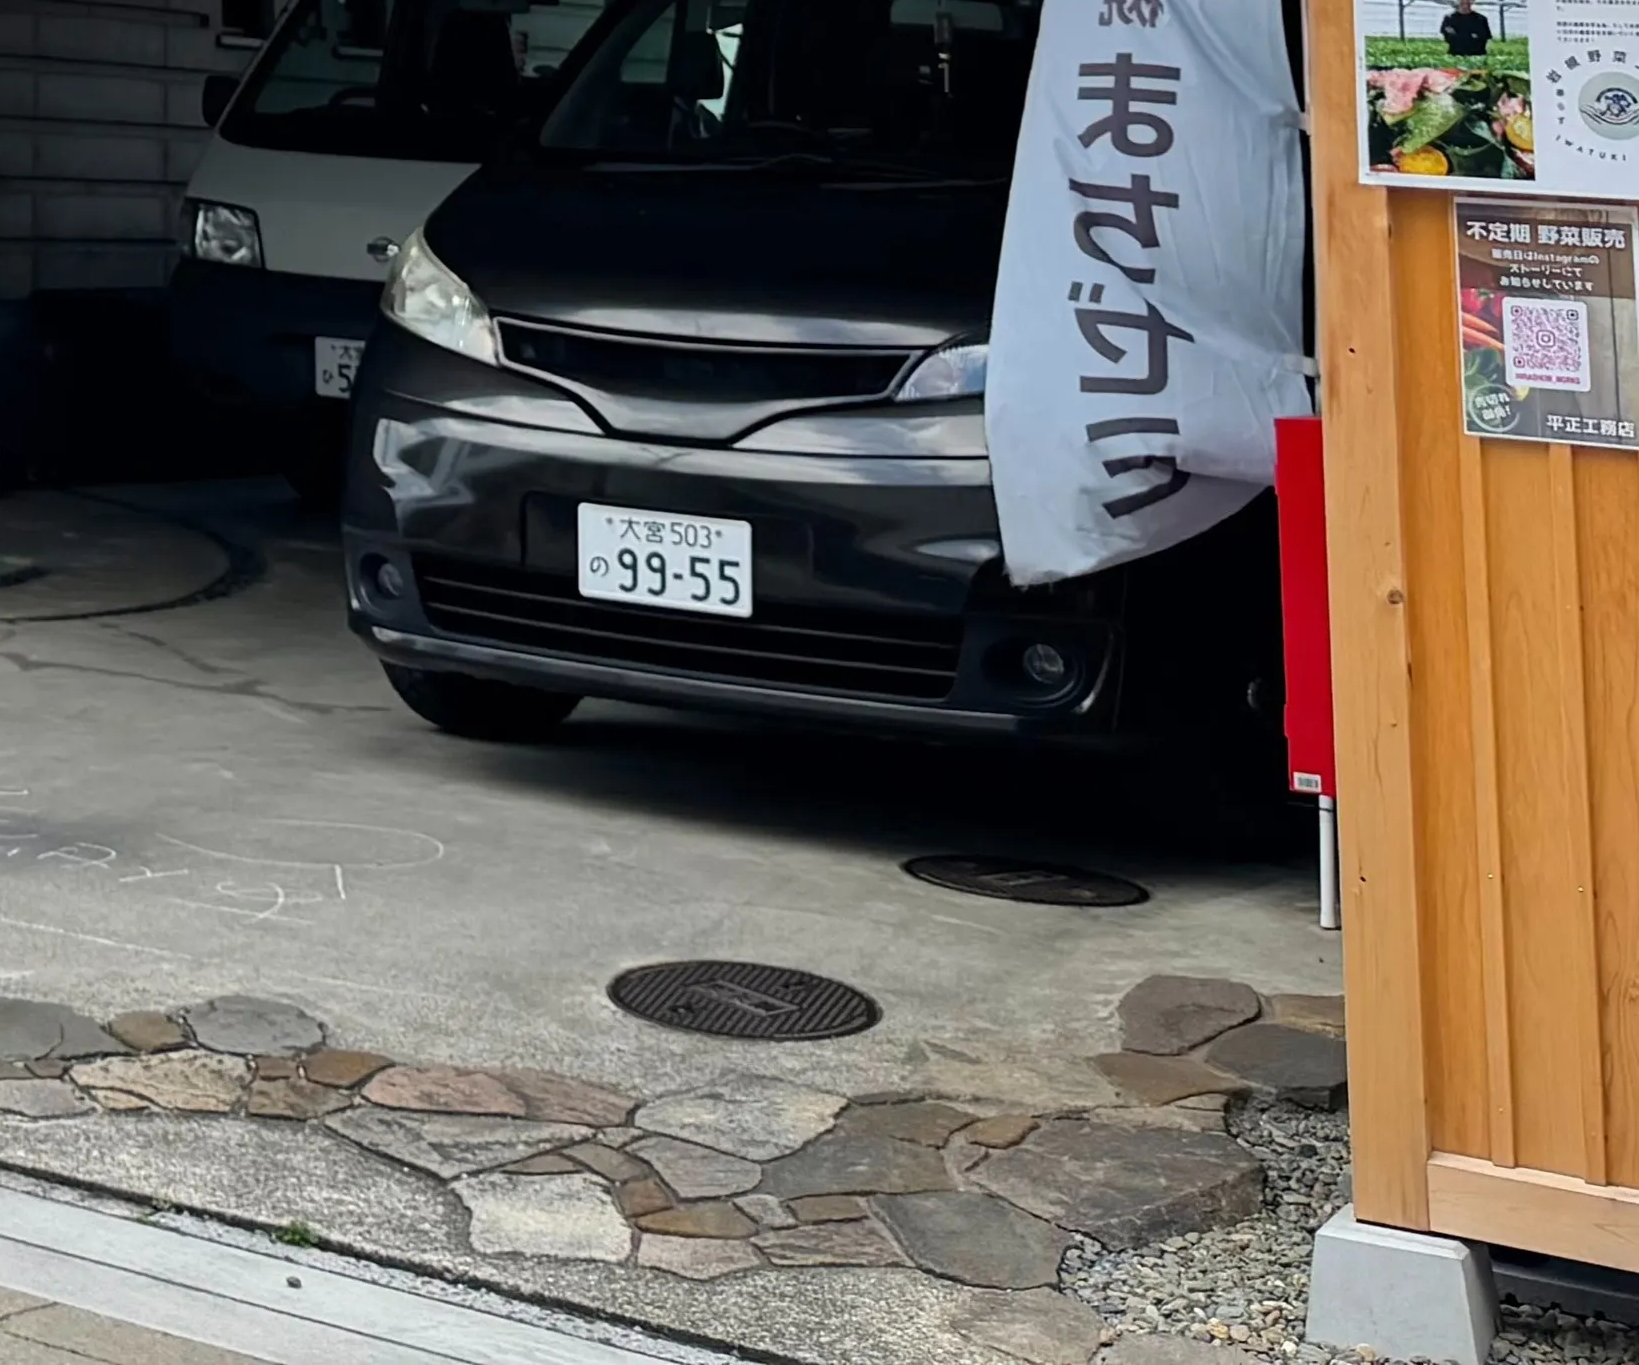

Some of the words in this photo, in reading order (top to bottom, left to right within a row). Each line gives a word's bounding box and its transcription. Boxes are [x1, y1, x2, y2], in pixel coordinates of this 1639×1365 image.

[1466, 221, 1531, 244] 不定期
[1537, 225, 1625, 249] 野菜販売
[1510, 263, 1582, 277] ストーリーにて
[1500, 276, 1594, 291] お知らせしています
[1546, 414, 1635, 437] 平正工務店
[619, 518, 665, 544] 大宮
[670, 522, 712, 549] 503
[589, 556, 610, 577] の
[617, 548, 740, 606] 99-55
